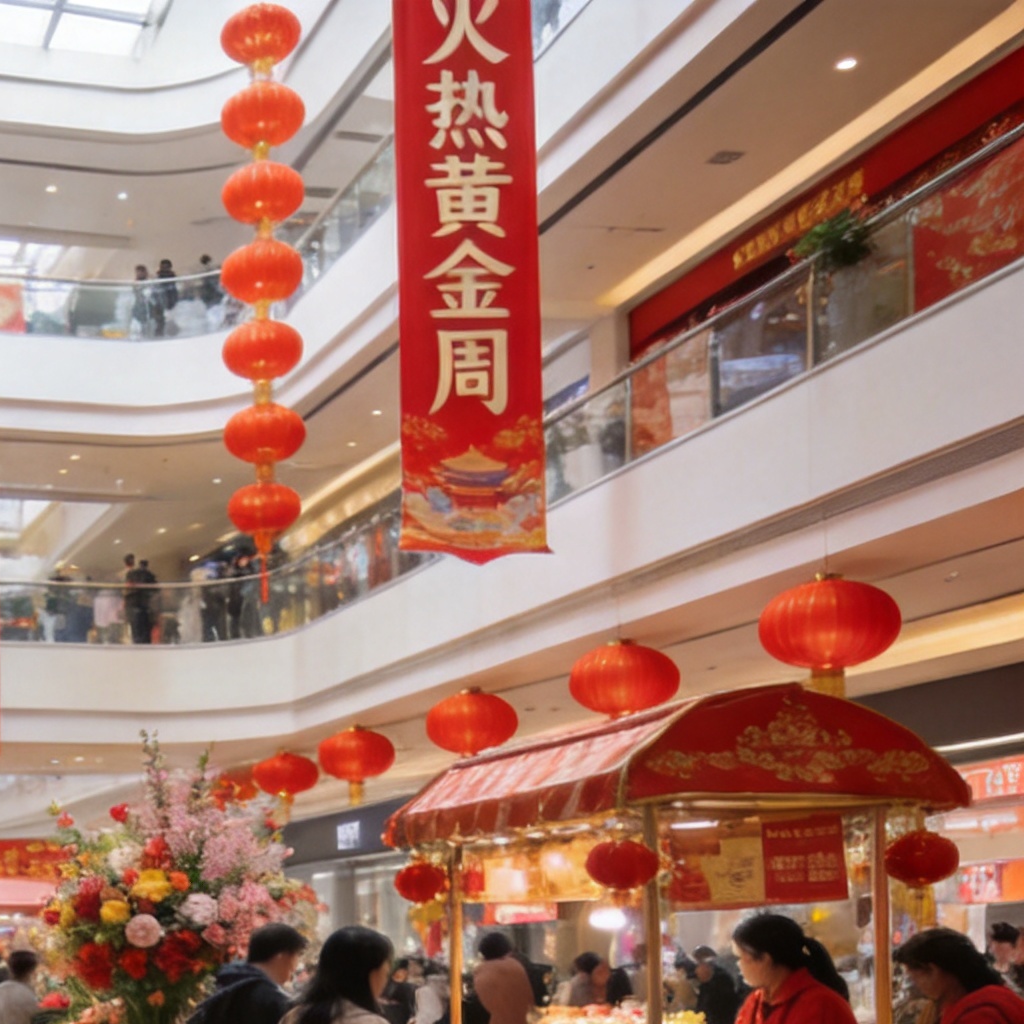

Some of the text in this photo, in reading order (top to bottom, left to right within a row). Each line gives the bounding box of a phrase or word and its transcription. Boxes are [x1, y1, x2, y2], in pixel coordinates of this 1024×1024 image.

[423, 0, 516, 416] 火热黄金周
